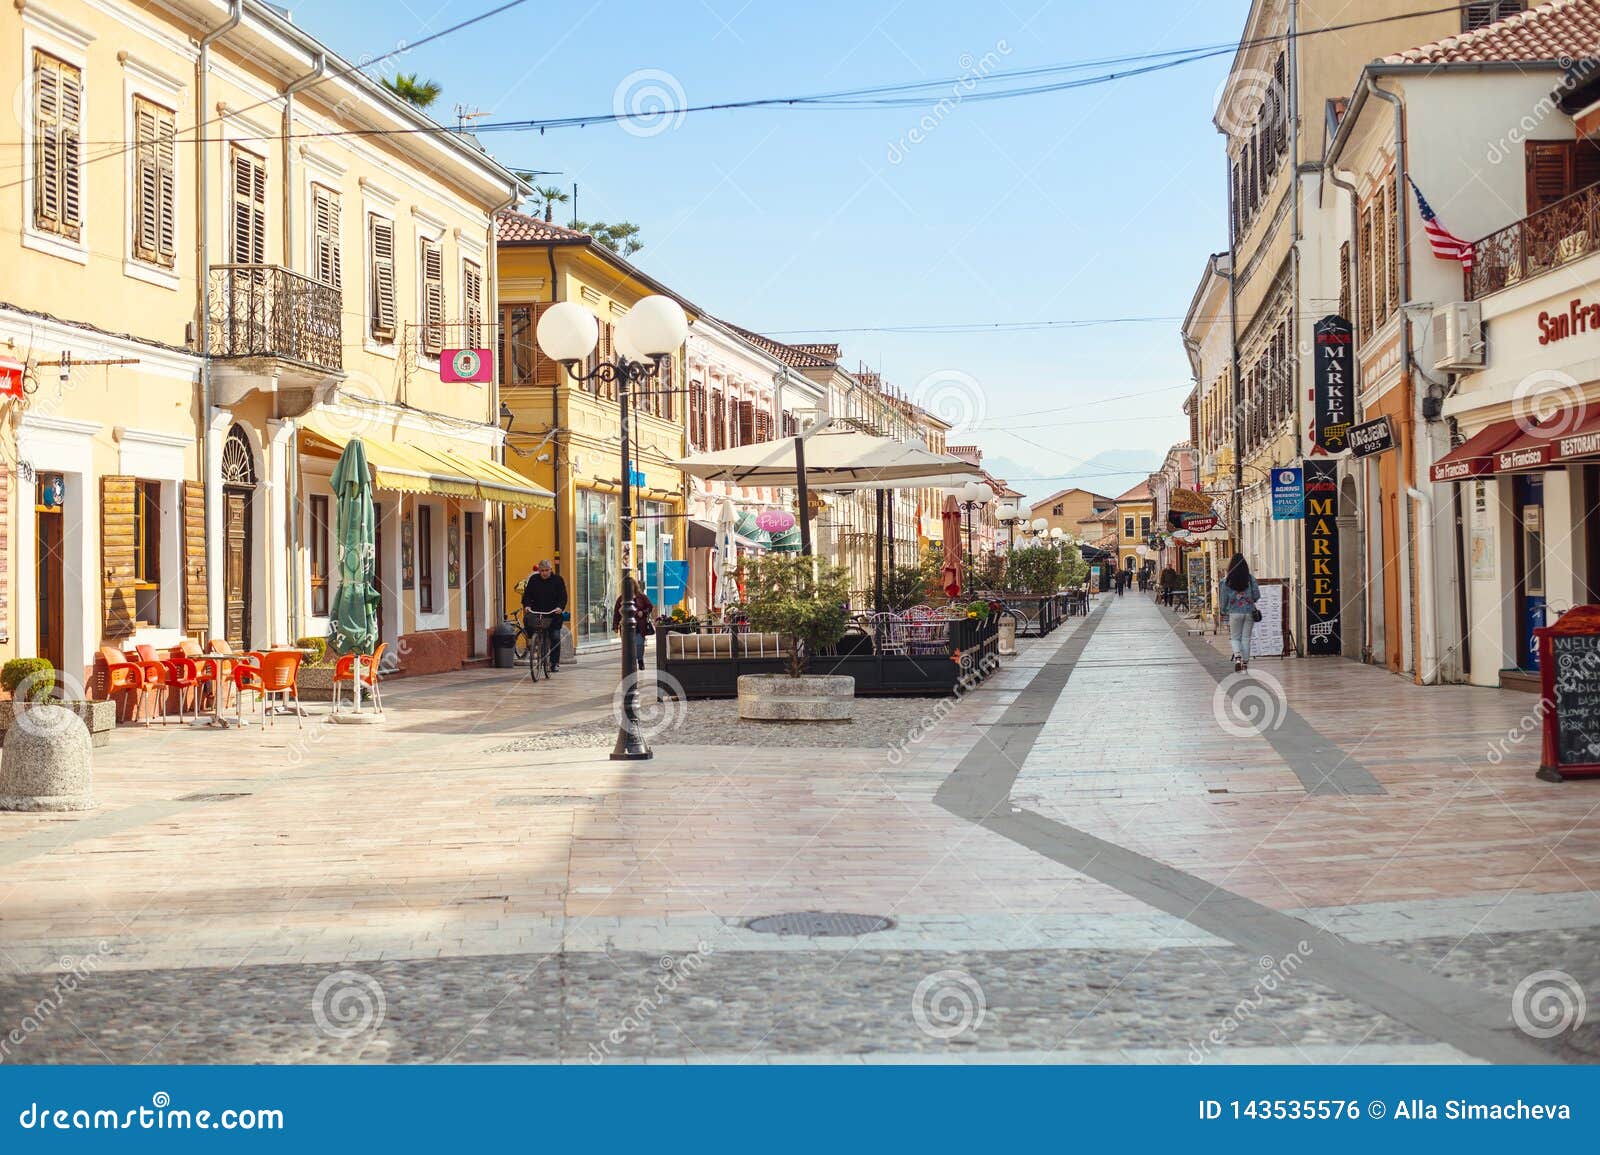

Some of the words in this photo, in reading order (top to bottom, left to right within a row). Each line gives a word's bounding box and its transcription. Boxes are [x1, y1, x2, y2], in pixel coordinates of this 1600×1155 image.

[1538, 311, 1569, 345] San
[1324, 346, 1345, 424] MARKET
[1364, 440, 1382, 452] 925
[1500, 454, 1512, 470] San
[1512, 449, 1542, 467] Francisco
[1435, 465, 1445, 480] San
[1445, 462, 1469, 477] Francisco
[760, 513, 790, 528] Perla
[1308, 498, 1334, 615] MARKET
